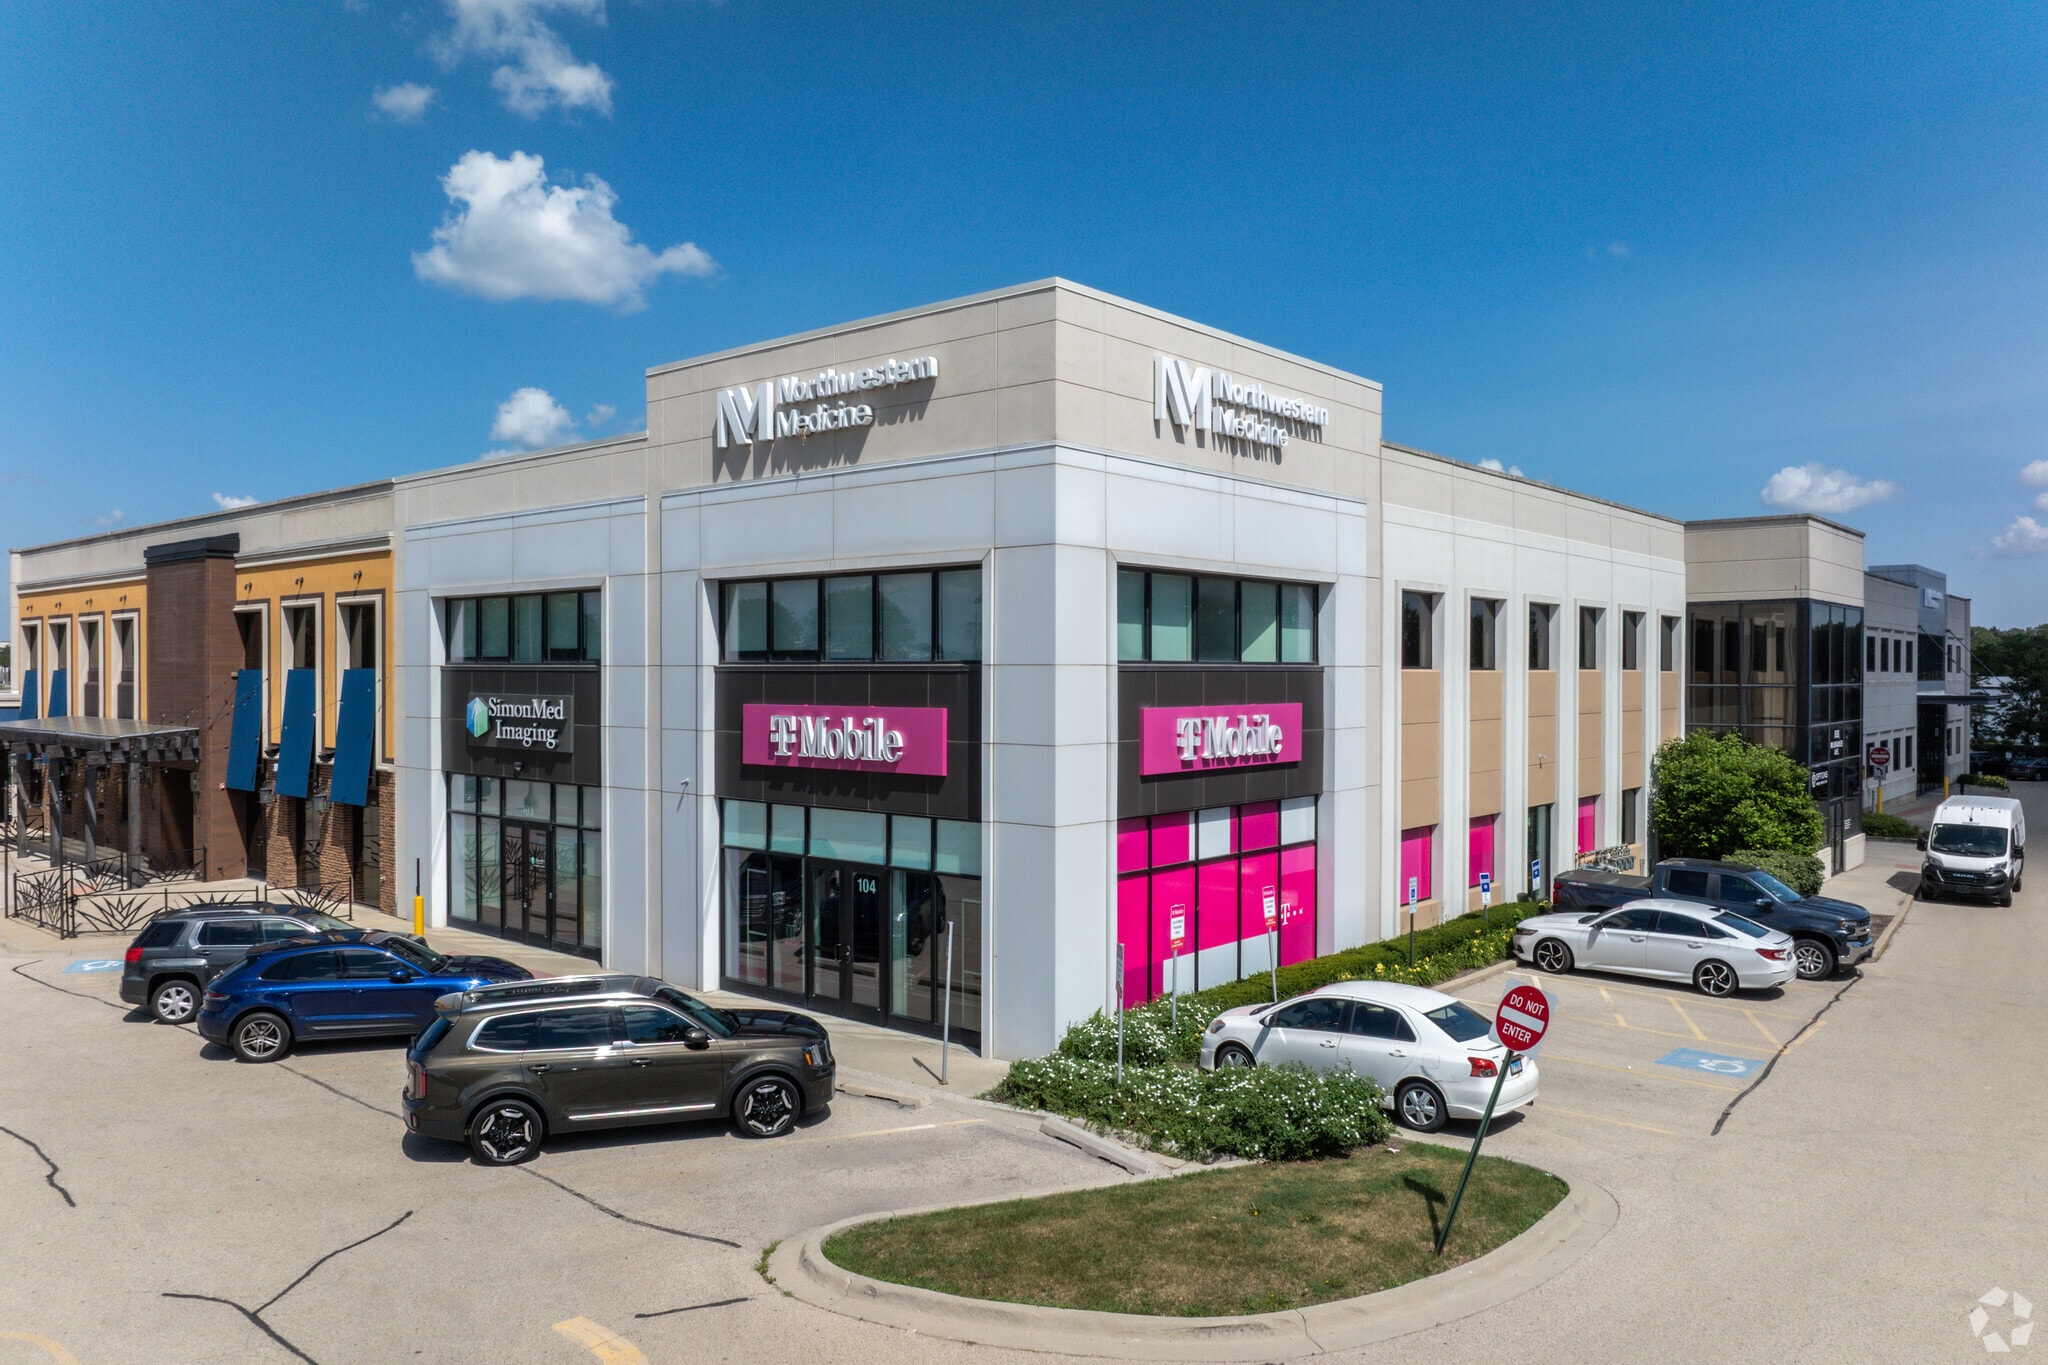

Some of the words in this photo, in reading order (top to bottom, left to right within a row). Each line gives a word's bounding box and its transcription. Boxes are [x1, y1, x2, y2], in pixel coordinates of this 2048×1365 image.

[776, 356, 938, 404] Northwestern
[1212, 371, 1329, 426] Northwestern
[776, 401, 874, 438] Medicine
[1212, 406, 1289, 448] Medicine
[488, 697, 565, 720] SimonMed
[495, 719, 559, 749] Imaging
[798, 715, 904, 763] Mobile
[1202, 714, 1283, 759] Mobile
[857, 878, 877, 894] 104
[1509, 993, 1524, 1008] DO
[1525, 1000, 1545, 1016] NOT
[1502, 1022, 1532, 1044] ENTER
